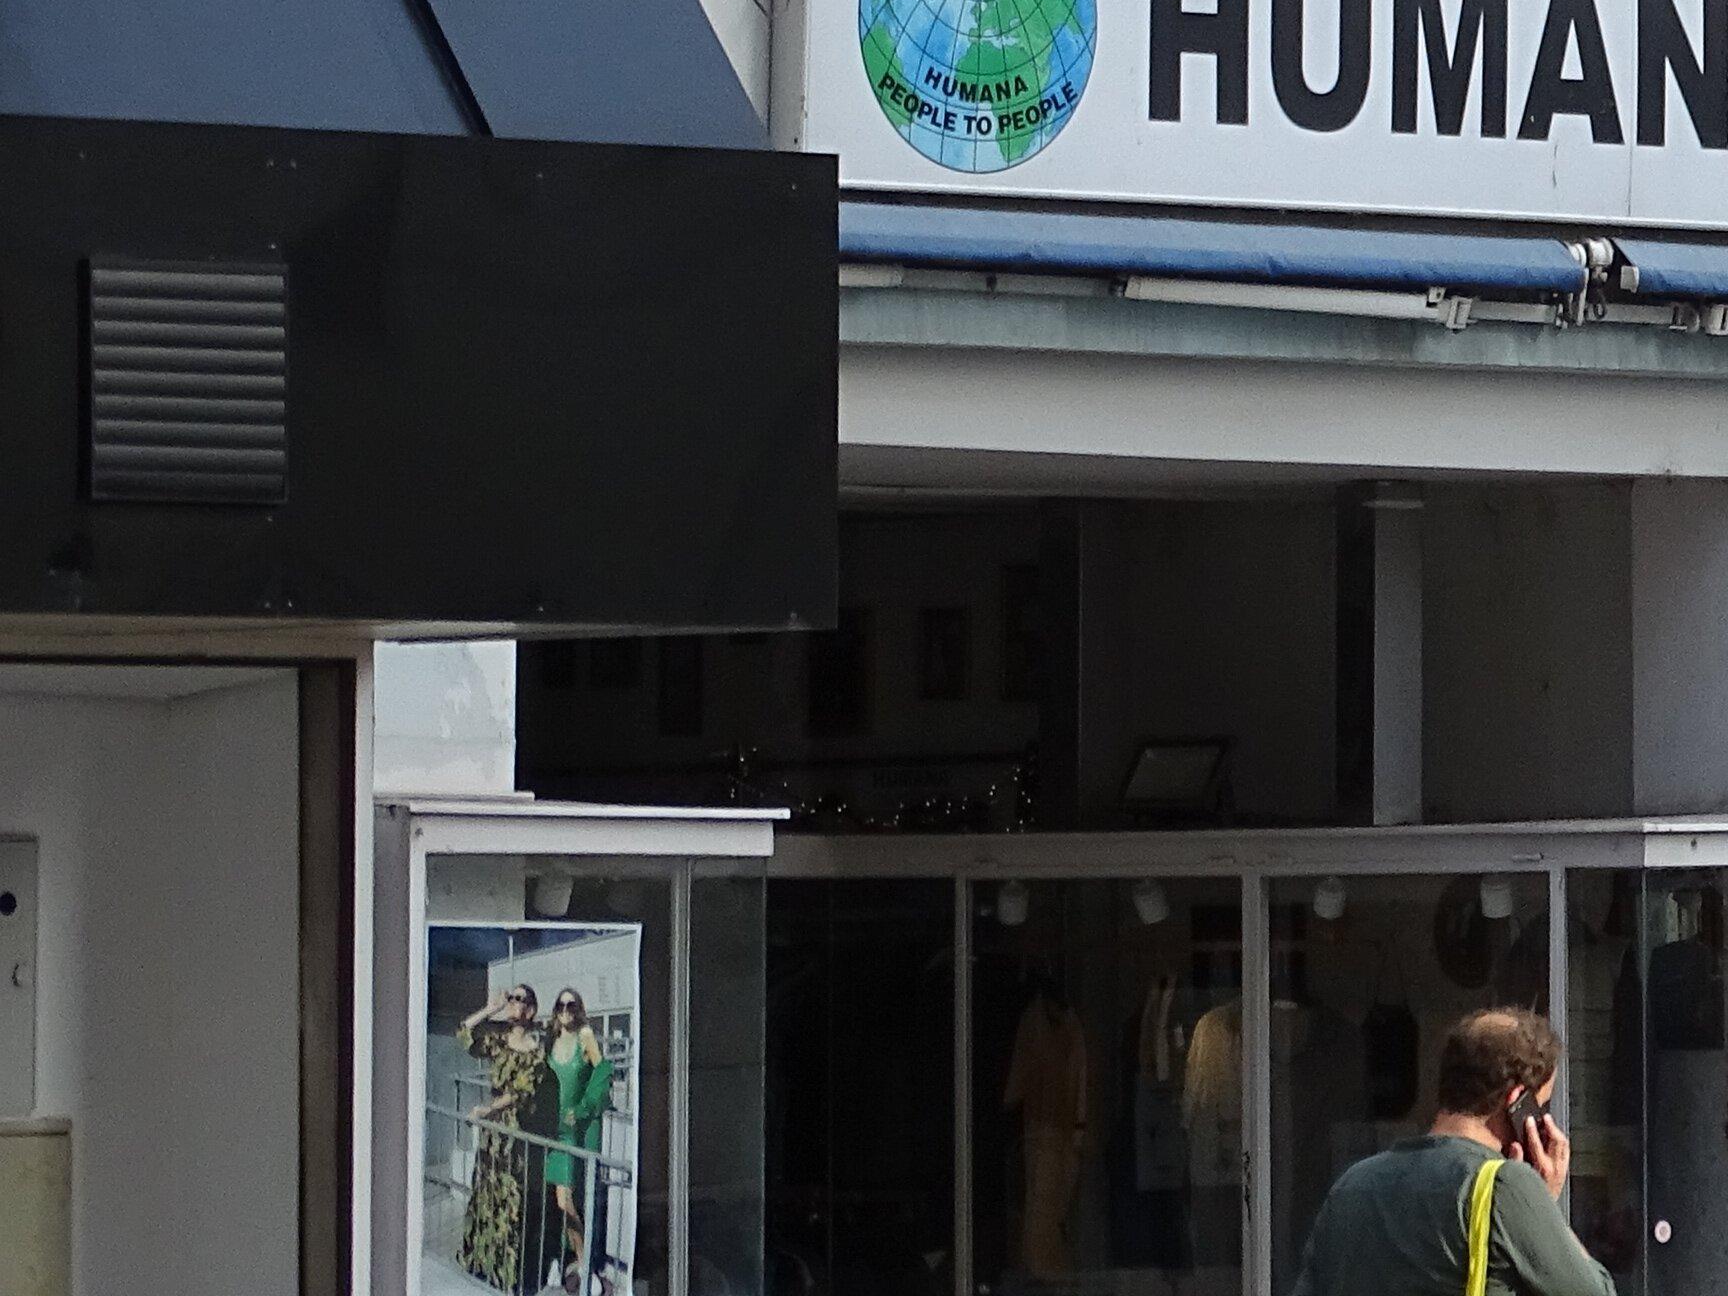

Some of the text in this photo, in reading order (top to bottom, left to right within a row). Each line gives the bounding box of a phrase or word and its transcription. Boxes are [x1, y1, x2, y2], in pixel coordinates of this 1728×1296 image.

[878, 72, 1078, 136] PEOPLE TO PEOPLE
[923, 66, 1028, 104] HUMANA
